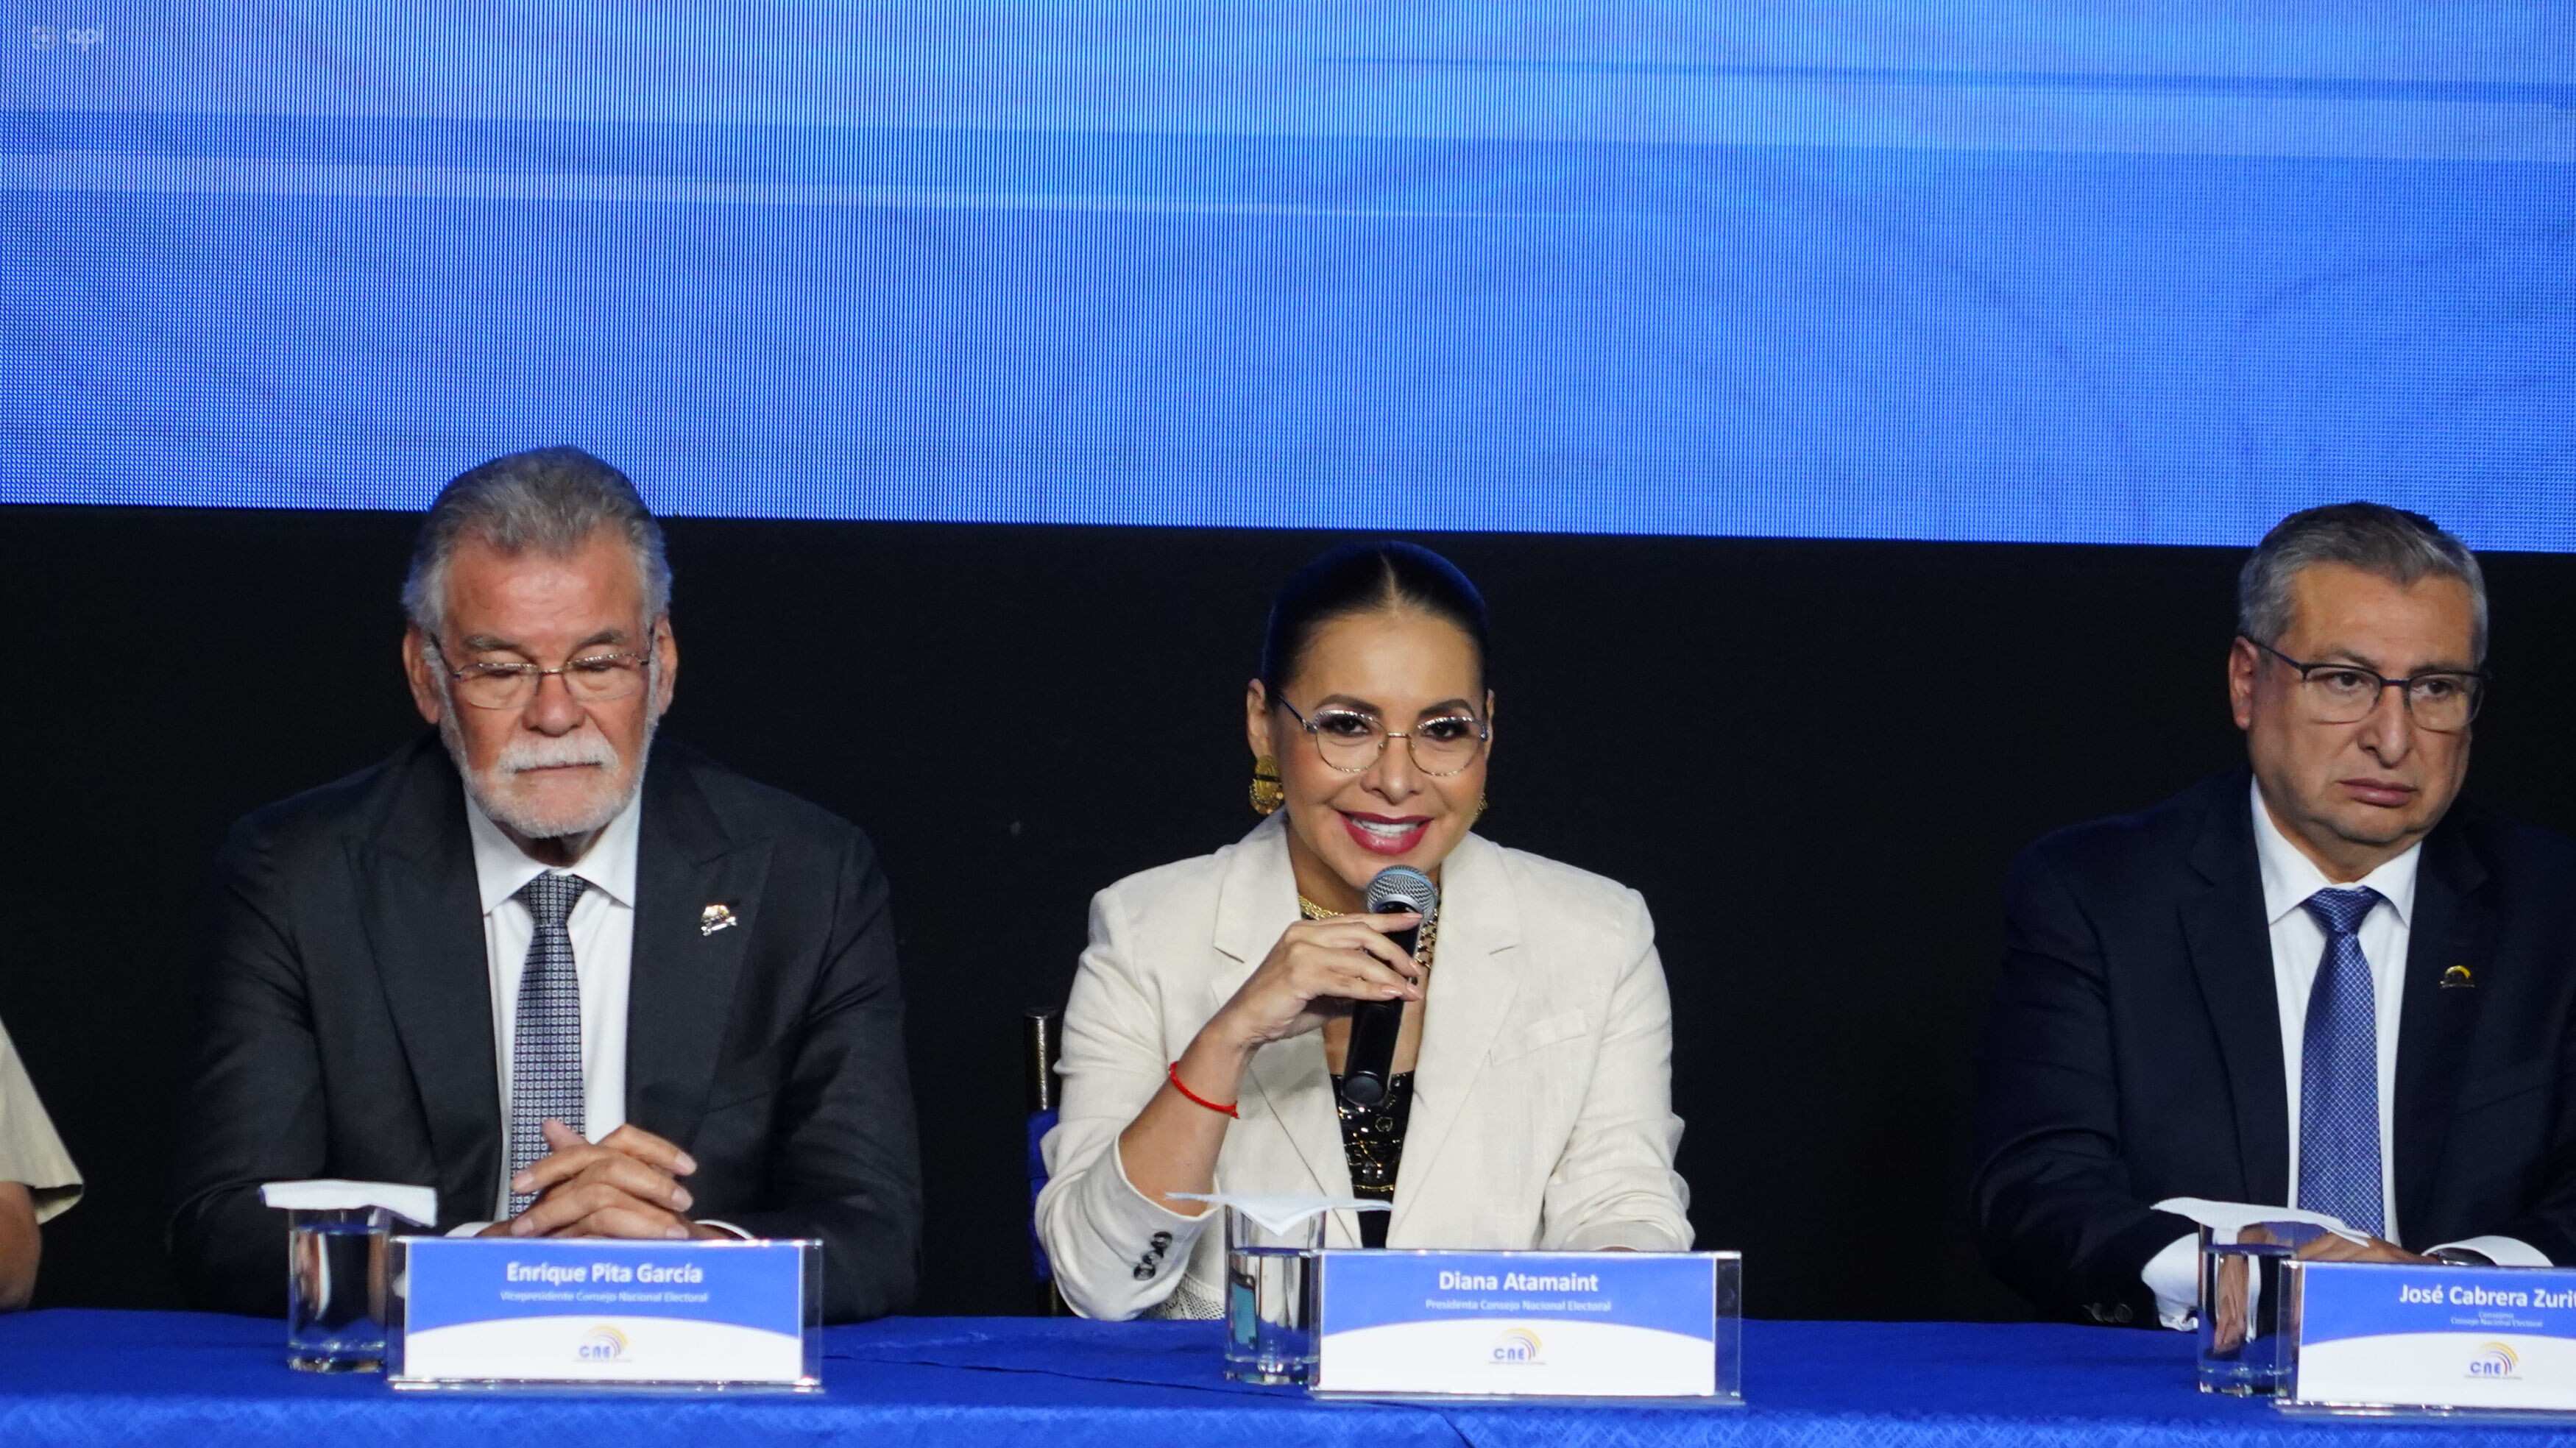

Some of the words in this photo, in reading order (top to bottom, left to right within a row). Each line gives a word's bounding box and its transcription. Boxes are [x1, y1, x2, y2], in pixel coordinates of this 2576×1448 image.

[506, 1262, 587, 1286] Enrique
[592, 1263, 632, 1283] Pita
[637, 1263, 704, 1283] García
[1439, 1271, 1498, 1291] Diana
[1504, 1272, 1599, 1292] Atamaint
[500, 1291, 574, 1303] Vicepresidente
[576, 1291, 617, 1303] Consejo
[619, 1291, 662, 1302] Nacional
[664, 1292, 708, 1303] Electoral
[1480, 1299, 1520, 1312] Consejo
[1522, 1300, 1565, 1311] Nacional
[1567, 1300, 1612, 1312] Electoral
[2399, 1284, 2444, 1304] José
[2449, 1285, 2528, 1307] Cabrera
[2533, 1289, 2576, 1308] Zuri
